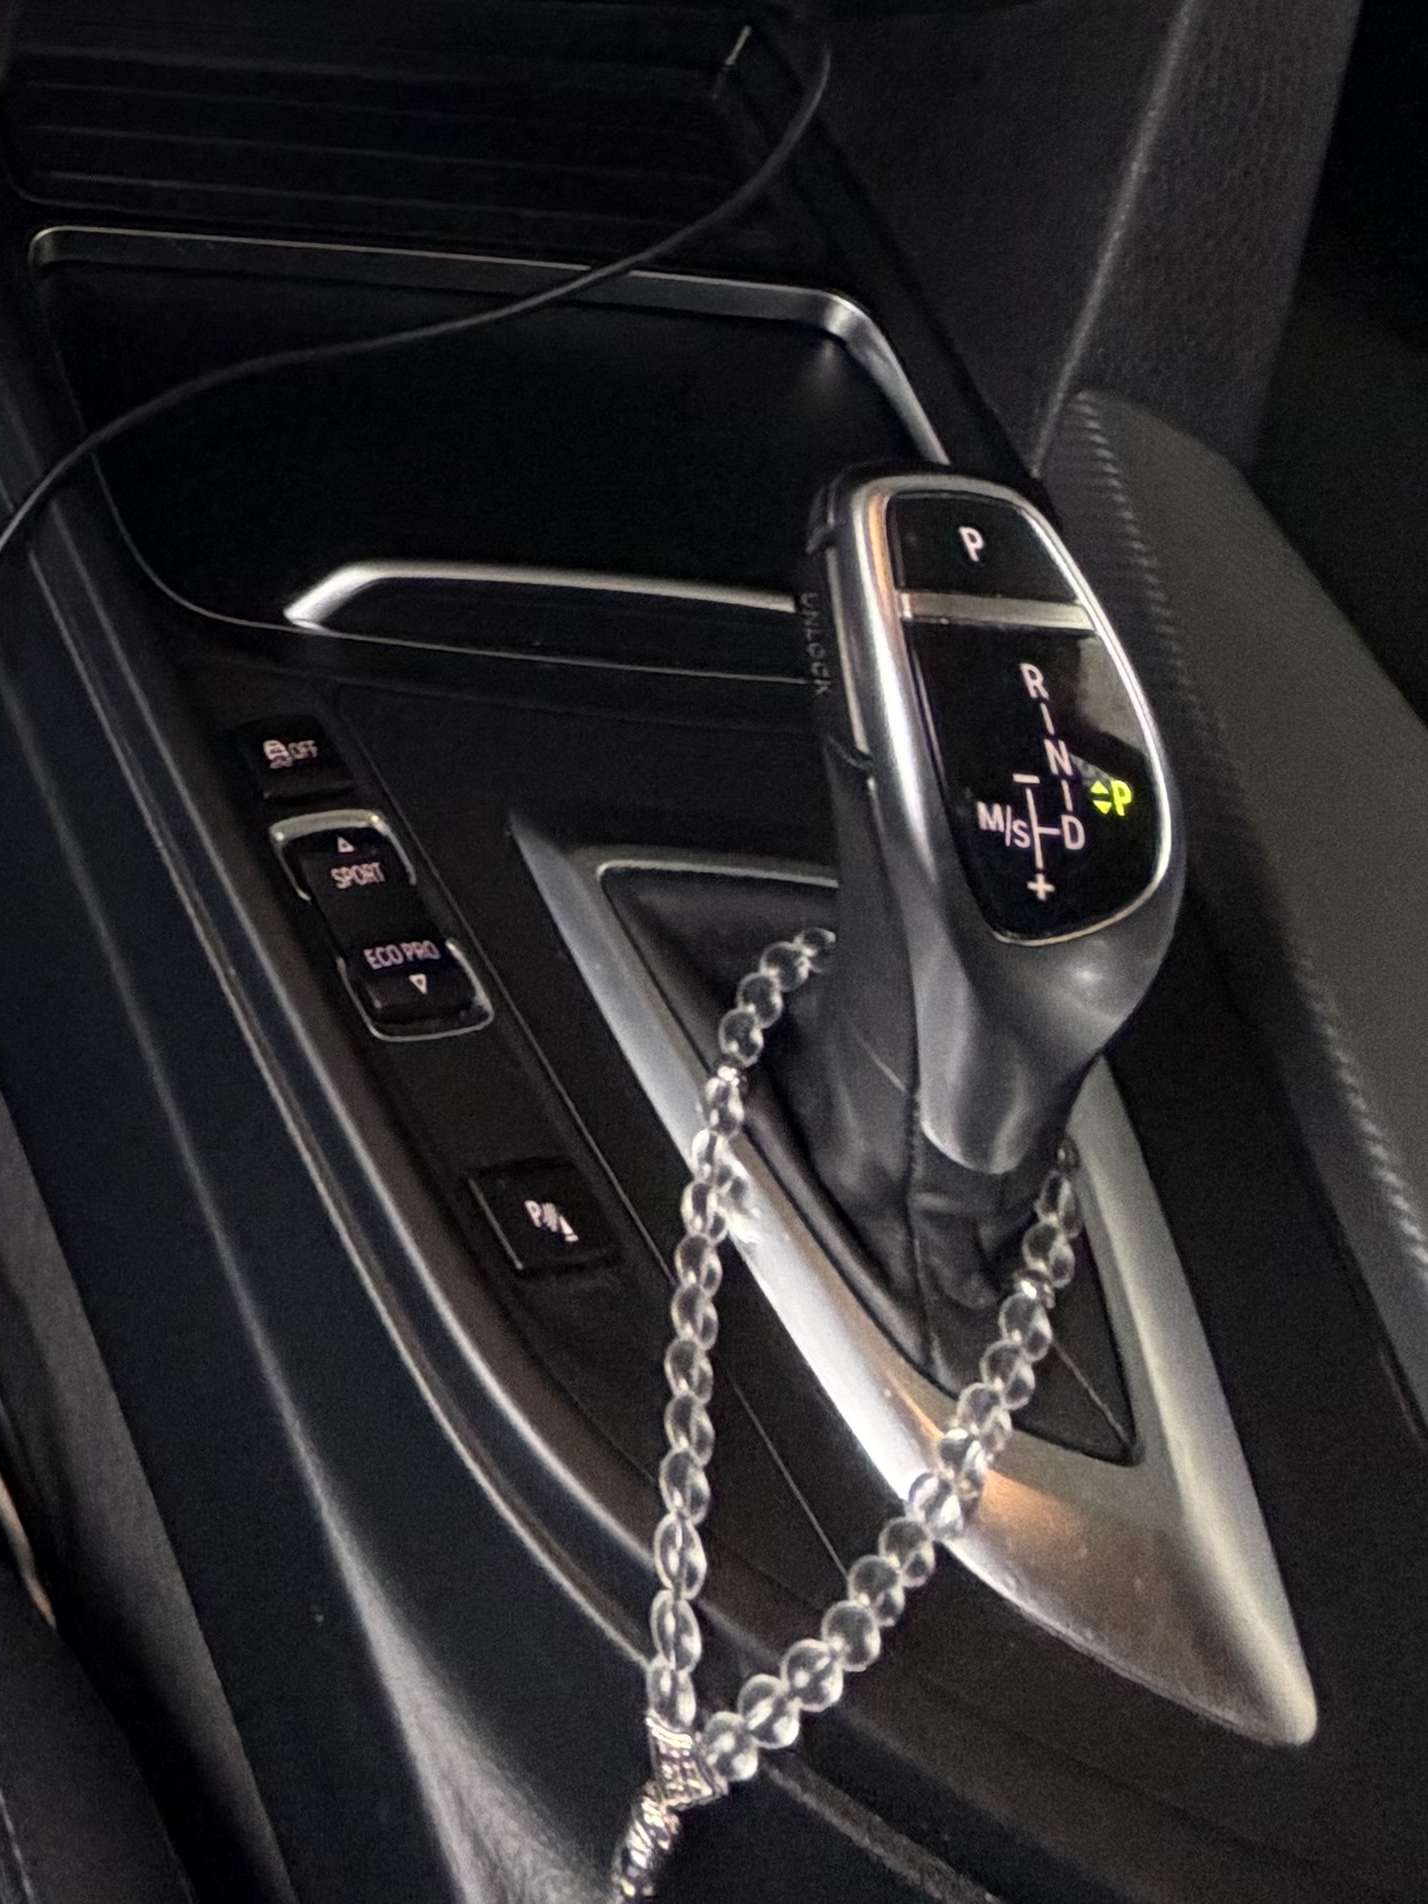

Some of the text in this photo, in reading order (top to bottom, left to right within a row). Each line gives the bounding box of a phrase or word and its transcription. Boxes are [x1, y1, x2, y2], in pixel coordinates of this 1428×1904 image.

[958, 527, 984, 562] P
[1020, 663, 1049, 699] R
[288, 740, 318, 760] OFF
[1044, 740, 1071, 775] N
[1110, 779, 1133, 816] P
[977, 802, 1031, 848] M/S
[1061, 816, 1085, 850] D
[330, 862, 385, 889] SPORT
[364, 940, 441, 970] ECO PRO
